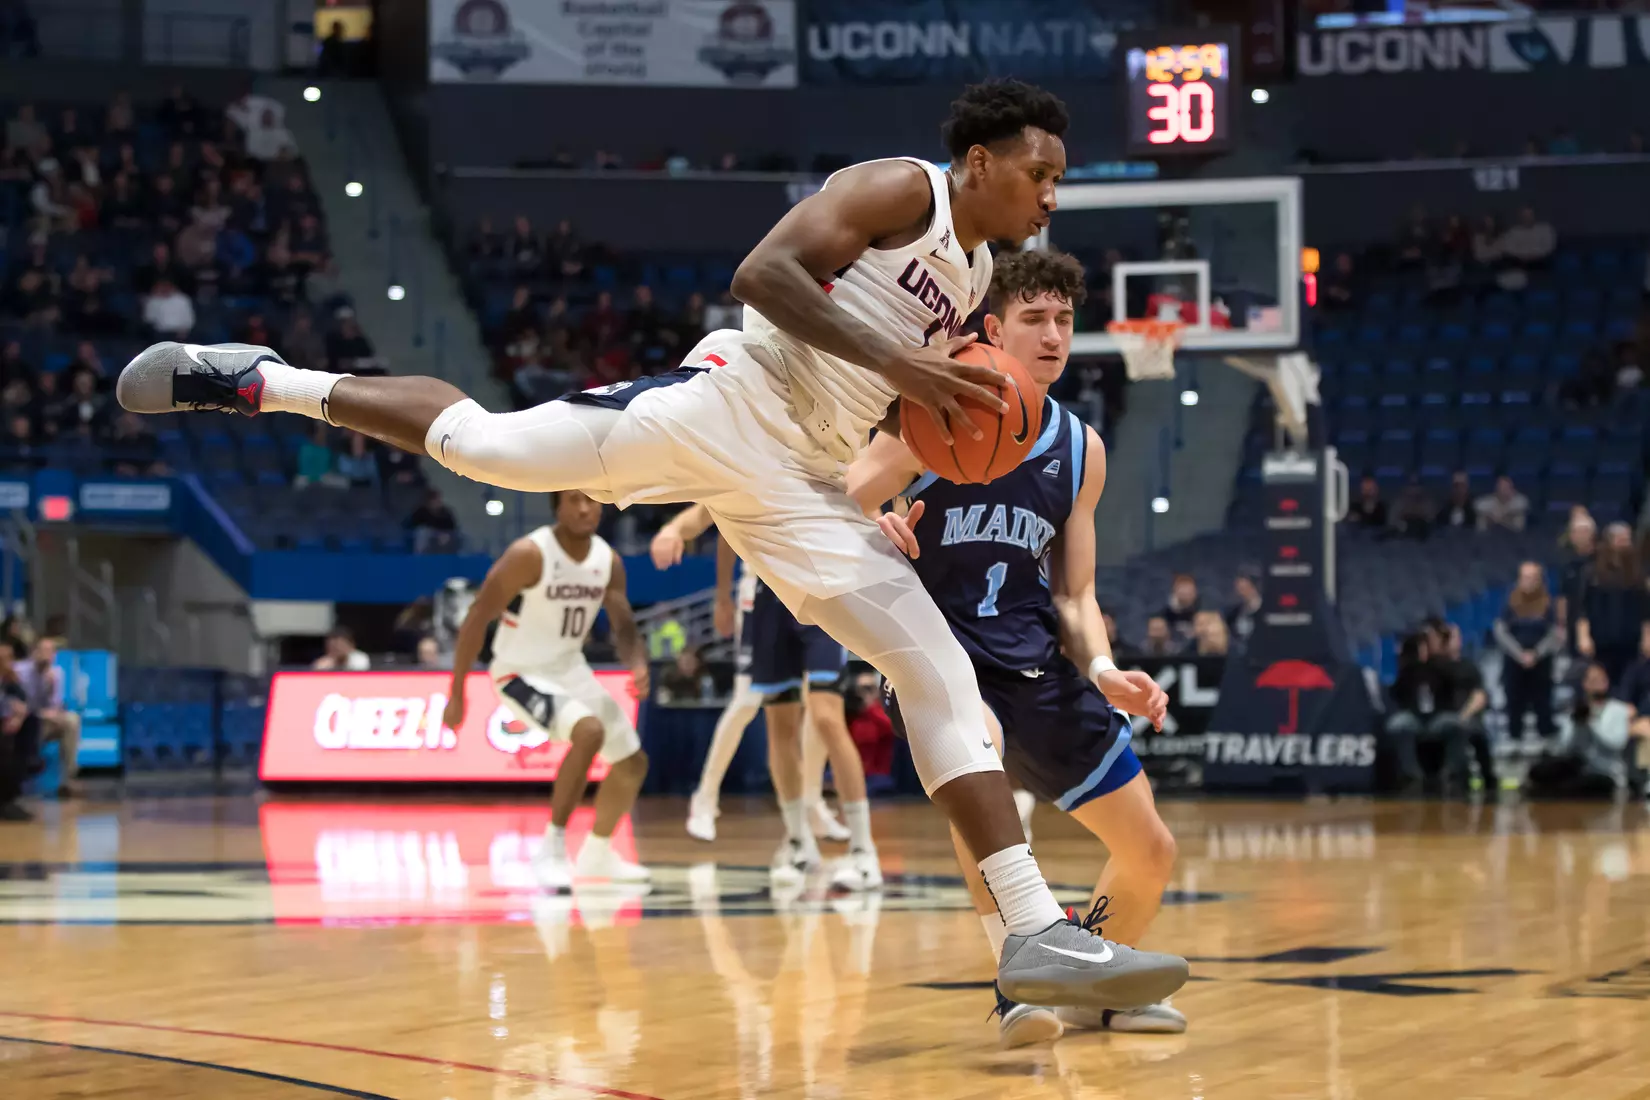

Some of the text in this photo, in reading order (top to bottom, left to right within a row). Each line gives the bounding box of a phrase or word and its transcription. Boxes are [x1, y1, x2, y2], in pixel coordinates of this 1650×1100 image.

[807, 20, 970, 60] UCONN
[979, 20, 1117, 60] NATI
[1298, 29, 1488, 75] UCONN
[1147, 82, 1214, 144] 30
[897, 257, 963, 341] UCON
[940, 504, 1056, 559] MAIN
[977, 562, 1008, 617] 1
[560, 606, 586, 638] 10
[1206, 733, 1377, 766] TRAVELERS
